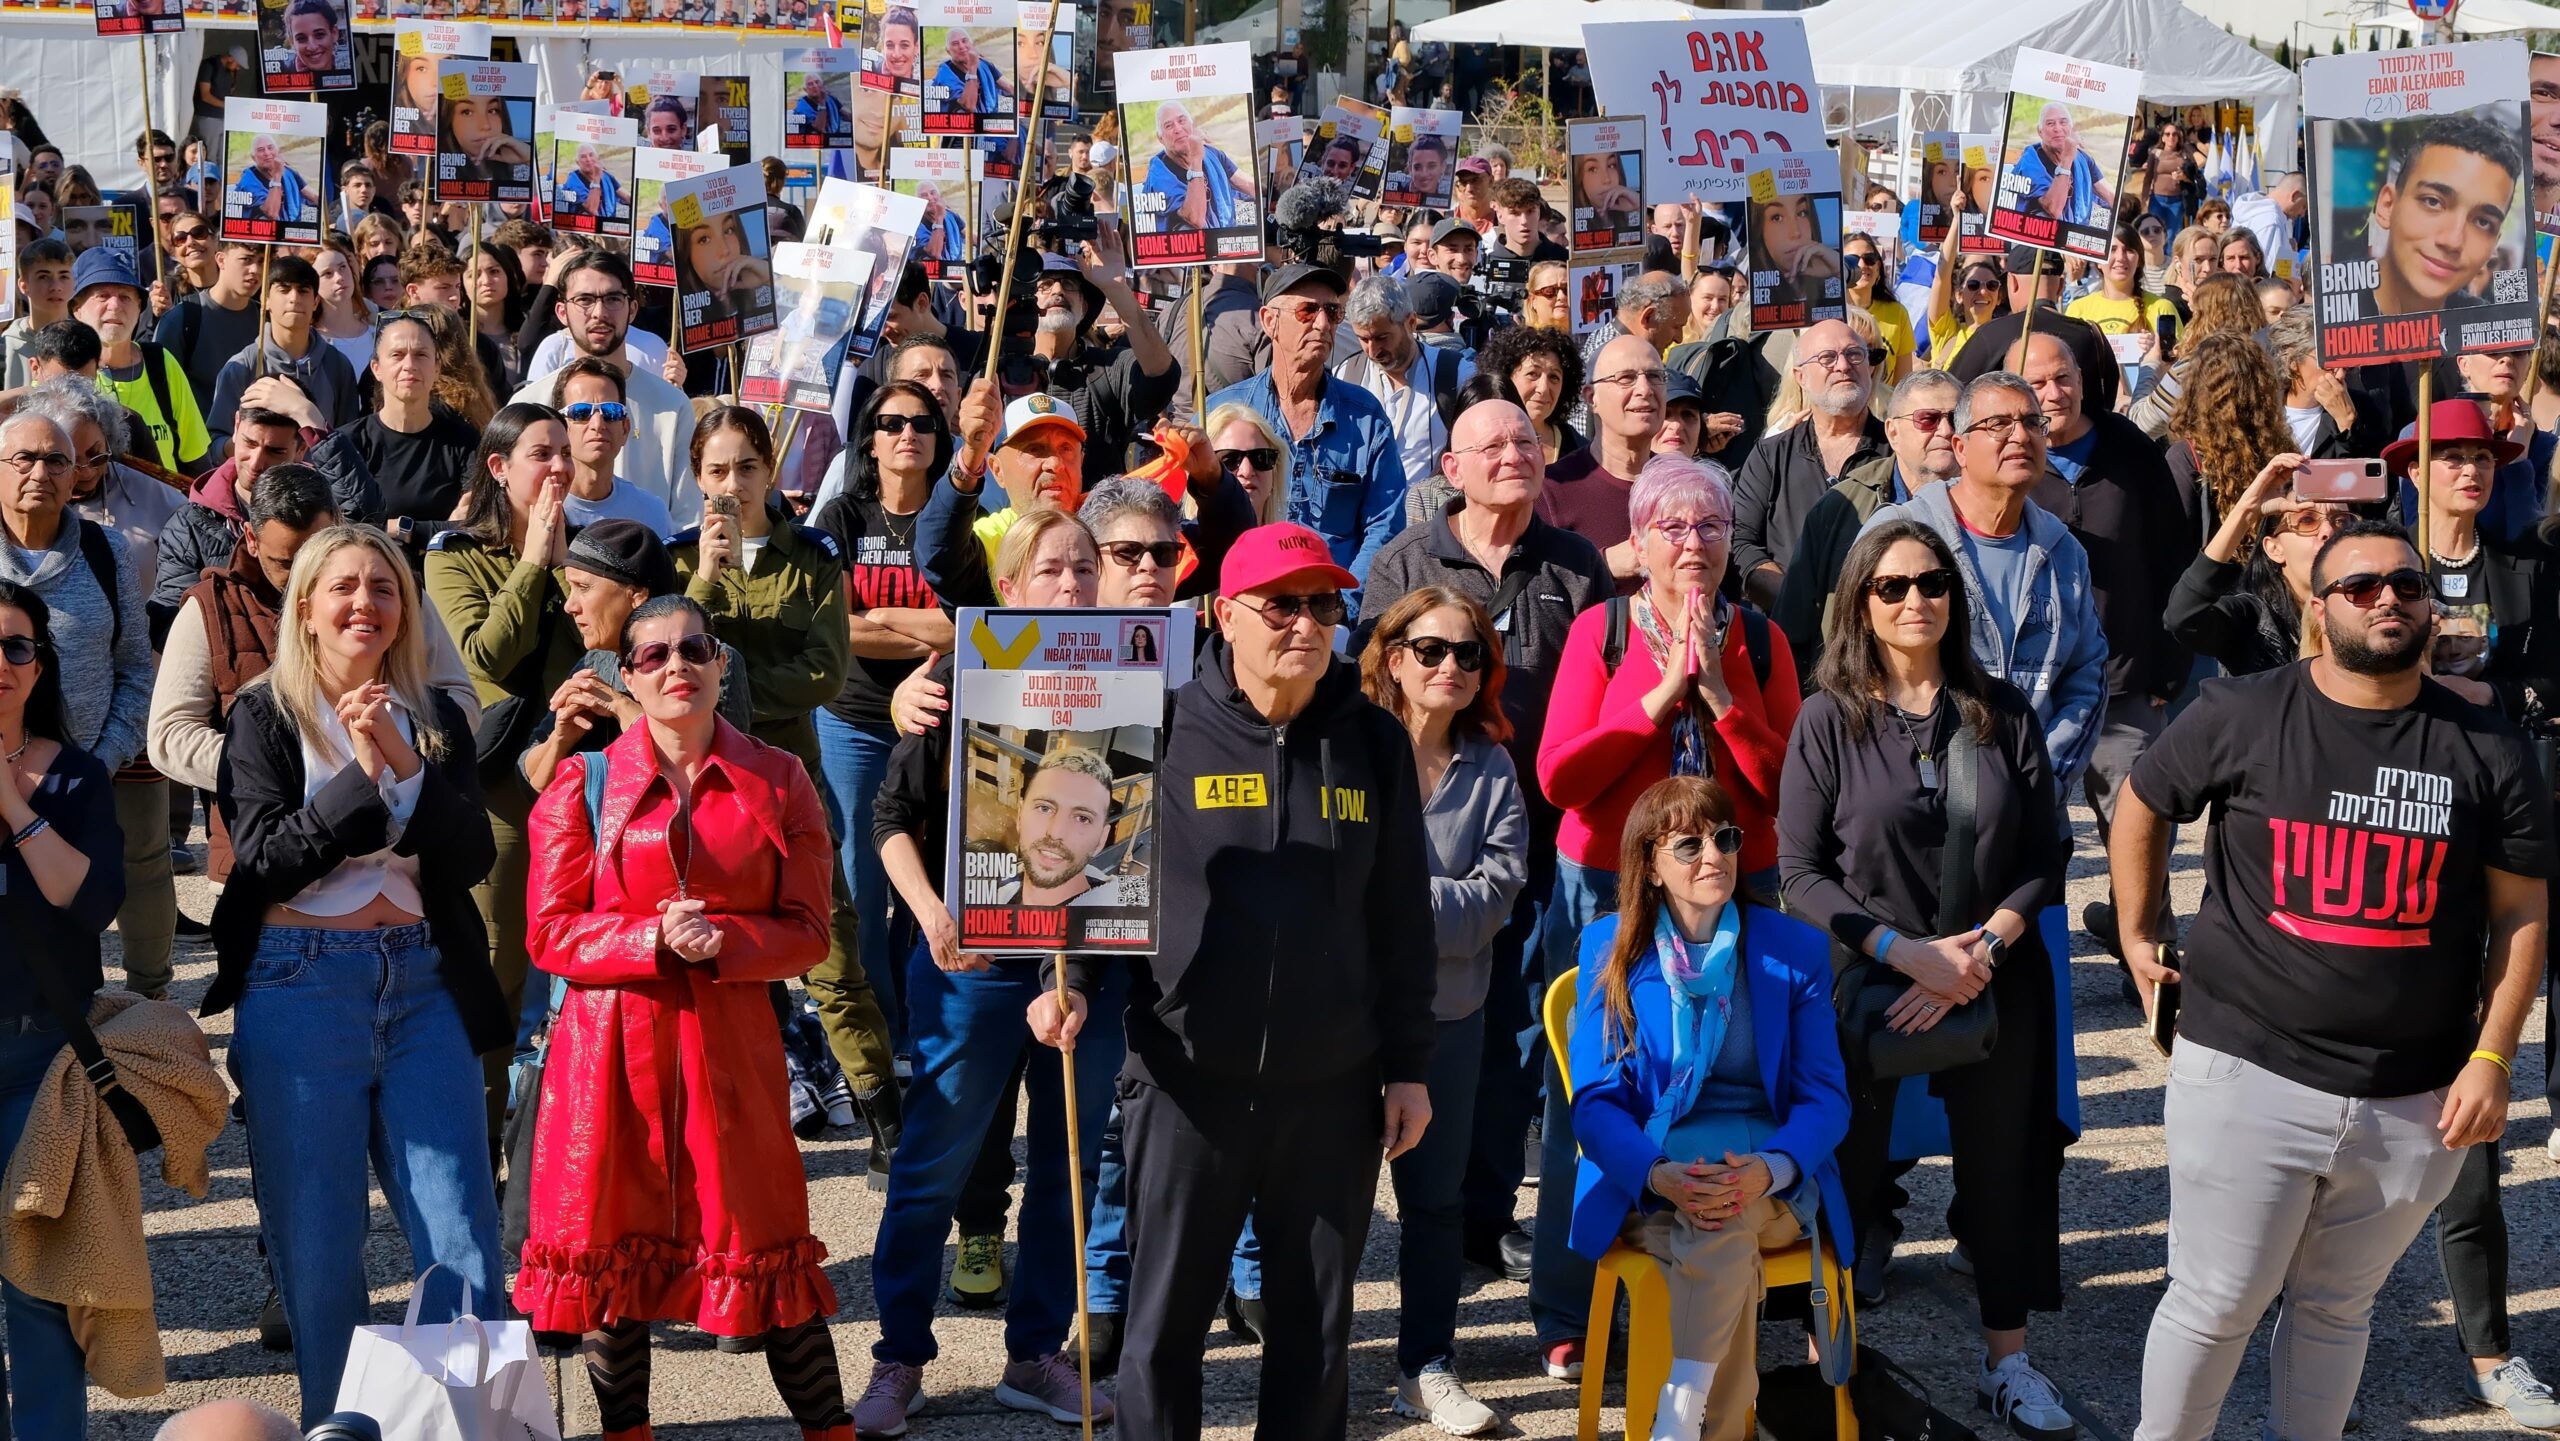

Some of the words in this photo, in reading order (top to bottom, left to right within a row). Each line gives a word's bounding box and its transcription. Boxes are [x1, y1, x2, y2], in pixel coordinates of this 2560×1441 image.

[1133, 3, 1150, 25] אל
[442, 34, 460, 42] BERGER
[1126, 25, 1150, 36] תשאירו
[1186, 54, 1198, 65] גדי
[1687, 31, 1768, 73] אגם
[1170, 55, 1186, 67] מוזס
[2378, 54, 2426, 75] אלכסנדר
[2430, 52, 2453, 70] עידן
[472, 74, 486, 84] AGAM
[487, 75, 506, 84] BERGER
[1151, 69, 1167, 82] GADI
[1168, 66, 1192, 80] MOSHE
[1193, 64, 1216, 78] MOZES
[1176, 80, 1191, 92] (80)
[2044, 71, 2061, 83] GADI
[2061, 75, 2083, 88] MOSHE
[2084, 79, 2106, 93] MOZES
[2368, 77, 2398, 96] EDAN
[2401, 70, 2465, 92] ALEXANDER
[726, 80, 748, 107] אל
[924, 86, 950, 99] BRING
[1701, 80, 1809, 114] מחכות
[2066, 86, 2080, 100] (80)
[924, 100, 940, 112] HIM
[2365, 94, 2401, 116] (21)
[283, 114, 300, 122] MOZES
[395, 107, 419, 120] BRING
[719, 107, 748, 119] תשאירו
[394, 120, 410, 132] HER
[731, 119, 748, 130] אותי
[924, 114, 948, 128] HOME
[951, 114, 974, 128] NOW!
[393, 135, 416, 148] HOME
[726, 131, 748, 142] מאחור
[440, 153, 466, 166] BRING
[440, 167, 456, 180] HER
[994, 164, 1013, 176] NOW!
[1778, 169, 1792, 179] AGAM
[1792, 168, 1812, 178] BERGER
[440, 181, 464, 194] HOME
[466, 181, 490, 194] NOW!
[1783, 180, 1798, 190] (20)
[2000, 172, 2032, 194] BRING
[226, 191, 253, 205] BRING
[702, 188, 718, 201] AGAM
[717, 184, 736, 198] BERGER
[1997, 190, 2018, 210] HIM
[1134, 192, 1166, 213] BRING
[1922, 204, 1940, 214] BRING
[225, 204, 244, 218] HIM
[1575, 207, 1594, 220] BRING
[1962, 212, 1984, 224] BRING
[108, 211, 134, 236] אל
[575, 215, 596, 227] NOW!
[1135, 213, 1156, 233] HIM
[1575, 220, 1588, 232] HER
[1922, 214, 1934, 226] HER
[1994, 208, 2024, 232] HOME
[2024, 216, 2059, 240] NOW!
[224, 220, 250, 234] HOME
[251, 220, 276, 236] NOW!
[1962, 224, 1976, 236] HER
[636, 236, 660, 251] BRING
[1136, 235, 1168, 256] HOME
[1170, 230, 1205, 254] NOW!
[1576, 231, 1594, 244] HOME
[1962, 237, 1982, 248] HOME
[1983, 238, 2004, 249] NOW!
[635, 249, 650, 263] HIM
[634, 264, 656, 279] HOME
[1754, 270, 1780, 288] BRING
[2320, 260, 2380, 294] BRING
[683, 290, 711, 310] BRING
[1753, 287, 1771, 304] HER
[1754, 304, 1778, 323] HOME
[1780, 301, 1806, 321] NOW!
[2322, 292, 2360, 324] HIM
[684, 310, 702, 327] HER
[2461, 322, 2492, 334] HOSTAGES
[2492, 320, 2504, 332] AND
[2506, 318, 2532, 329] MISSING
[686, 324, 711, 345] HOME
[712, 316, 737, 338] NOW!
[2324, 324, 2379, 357] HOME
[2384, 314, 2440, 352] NOW!
[2461, 331, 2500, 347] FAMILIES
[2502, 328, 2533, 344] FORUM
[751, 346, 774, 361] BRING
[748, 361, 760, 376] HIM
[744, 383, 766, 396] HOME
[857, 536, 887, 551] BRING
[856, 550, 882, 564] THEM
[884, 550, 911, 566] HOME
[1058, 632, 1078, 648] הימן
[1080, 632, 1100, 646] ענבר
[1044, 648, 1071, 662] INBAR
[1074, 648, 1112, 662] HAYMAN
[1028, 676, 1062, 690] בוחבוט
[1065, 676, 1097, 693] אלקנה
[1022, 692, 1060, 708] ELKANA
[1063, 694, 1103, 708] BOHBOT
[1052, 710, 1073, 726] (34)
[1206, 778, 1258, 804] 482
[2375, 766, 2452, 804] מחזירים
[2328, 790, 2395, 828] הביתה
[2398, 800, 2451, 836] אותם
[965, 852, 1018, 879] BRING
[2268, 818, 2448, 924] עכשיו
[965, 880, 998, 905] HIM
[964, 909, 1012, 935] HOME
[1017, 908, 1068, 936] NOW!
[1086, 918, 1112, 928] HOSTAGES
[1113, 919, 1124, 928] AND
[1124, 920, 1149, 928] MISSING
[1086, 928, 1120, 940] FAMILIES
[1121, 928, 1149, 940] FORUM
